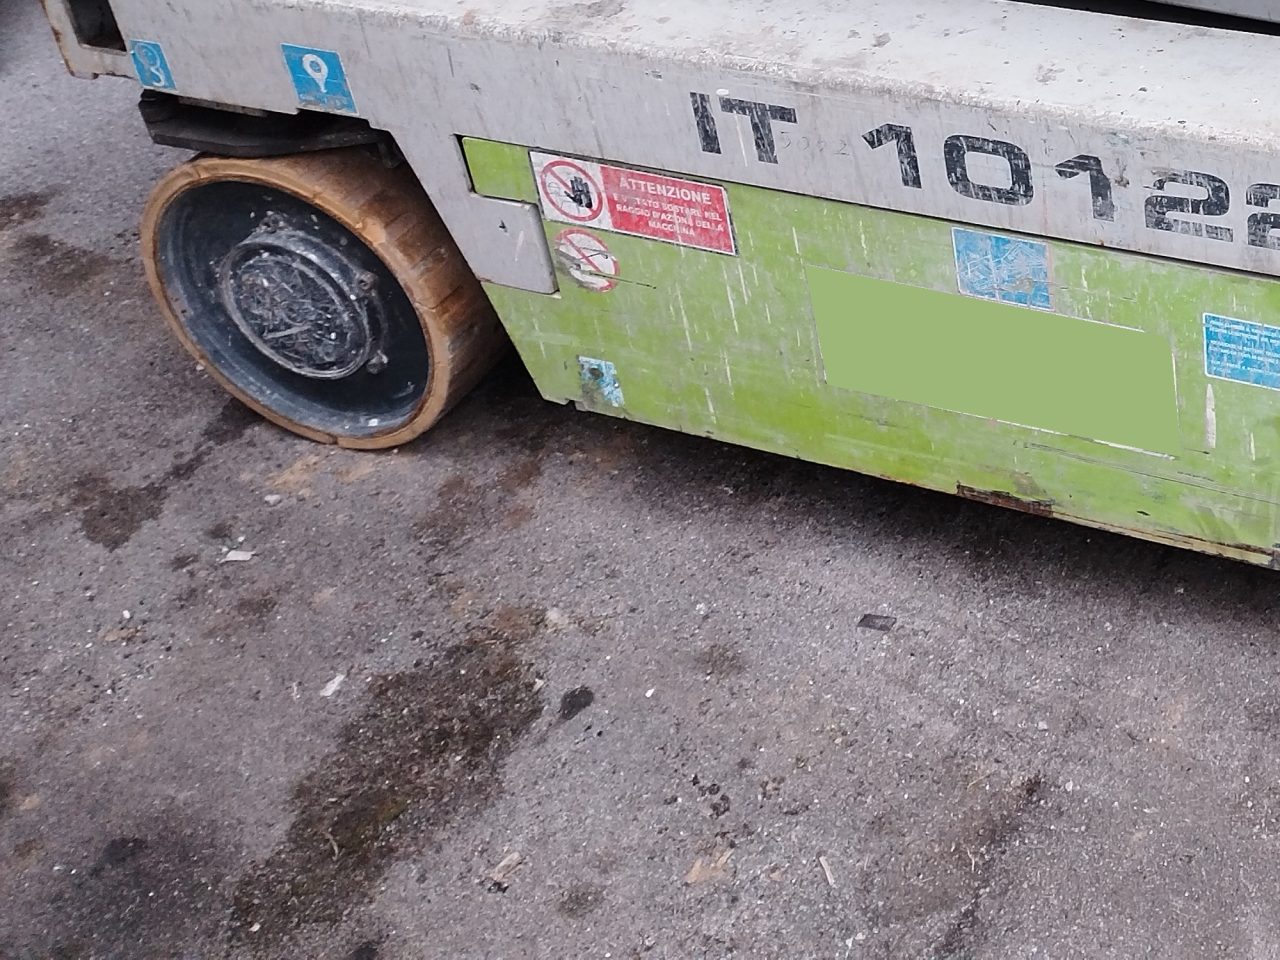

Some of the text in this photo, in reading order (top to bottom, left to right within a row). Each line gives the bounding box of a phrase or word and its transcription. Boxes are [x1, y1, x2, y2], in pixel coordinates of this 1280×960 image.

[690, 91, 798, 165] IT
[620, 177, 712, 205] ATTENZIONE
[616, 204, 651, 217] RAGGIO
[696, 219, 724, 232] DELLA
[704, 211, 723, 221] NEL
